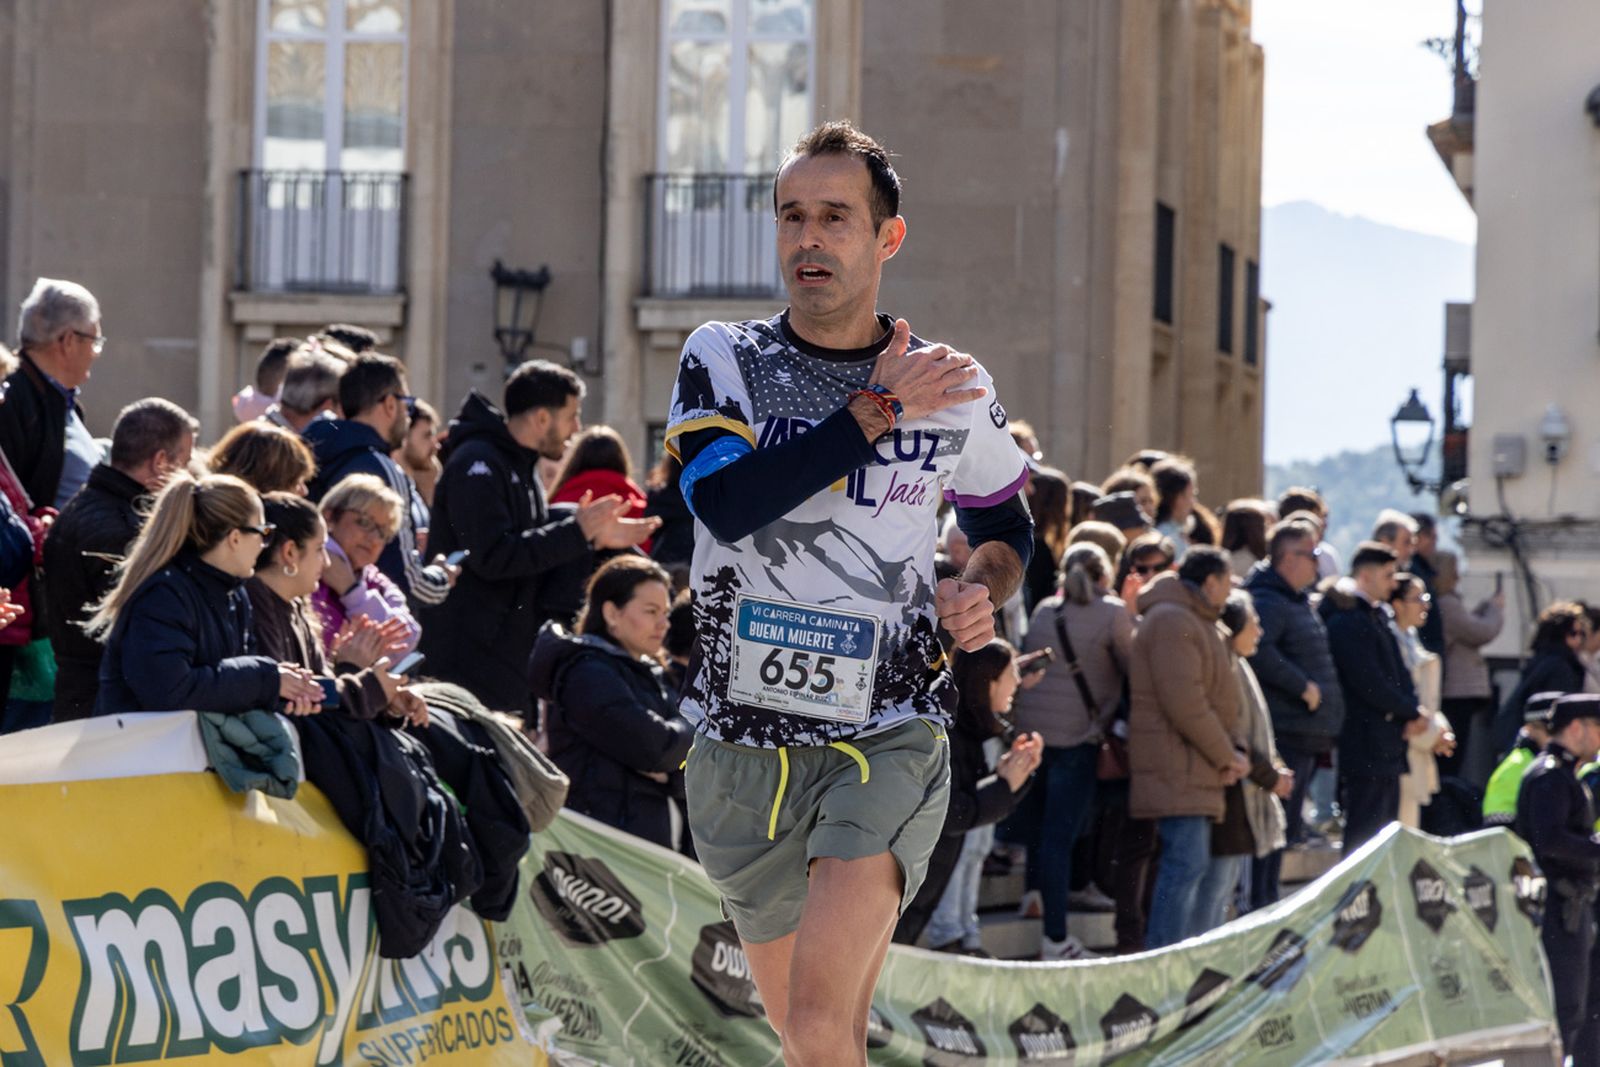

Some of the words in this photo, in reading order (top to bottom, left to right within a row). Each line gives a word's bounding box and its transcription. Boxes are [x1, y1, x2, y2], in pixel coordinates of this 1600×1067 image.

[752, 605, 761, 614] VI
[763, 607, 807, 624] CARRERA
[809, 615, 860, 632] CAMINATA
[749, 621, 784, 642] BUENA
[788, 628, 835, 649] MUERTE
[760, 648, 836, 694] 655
